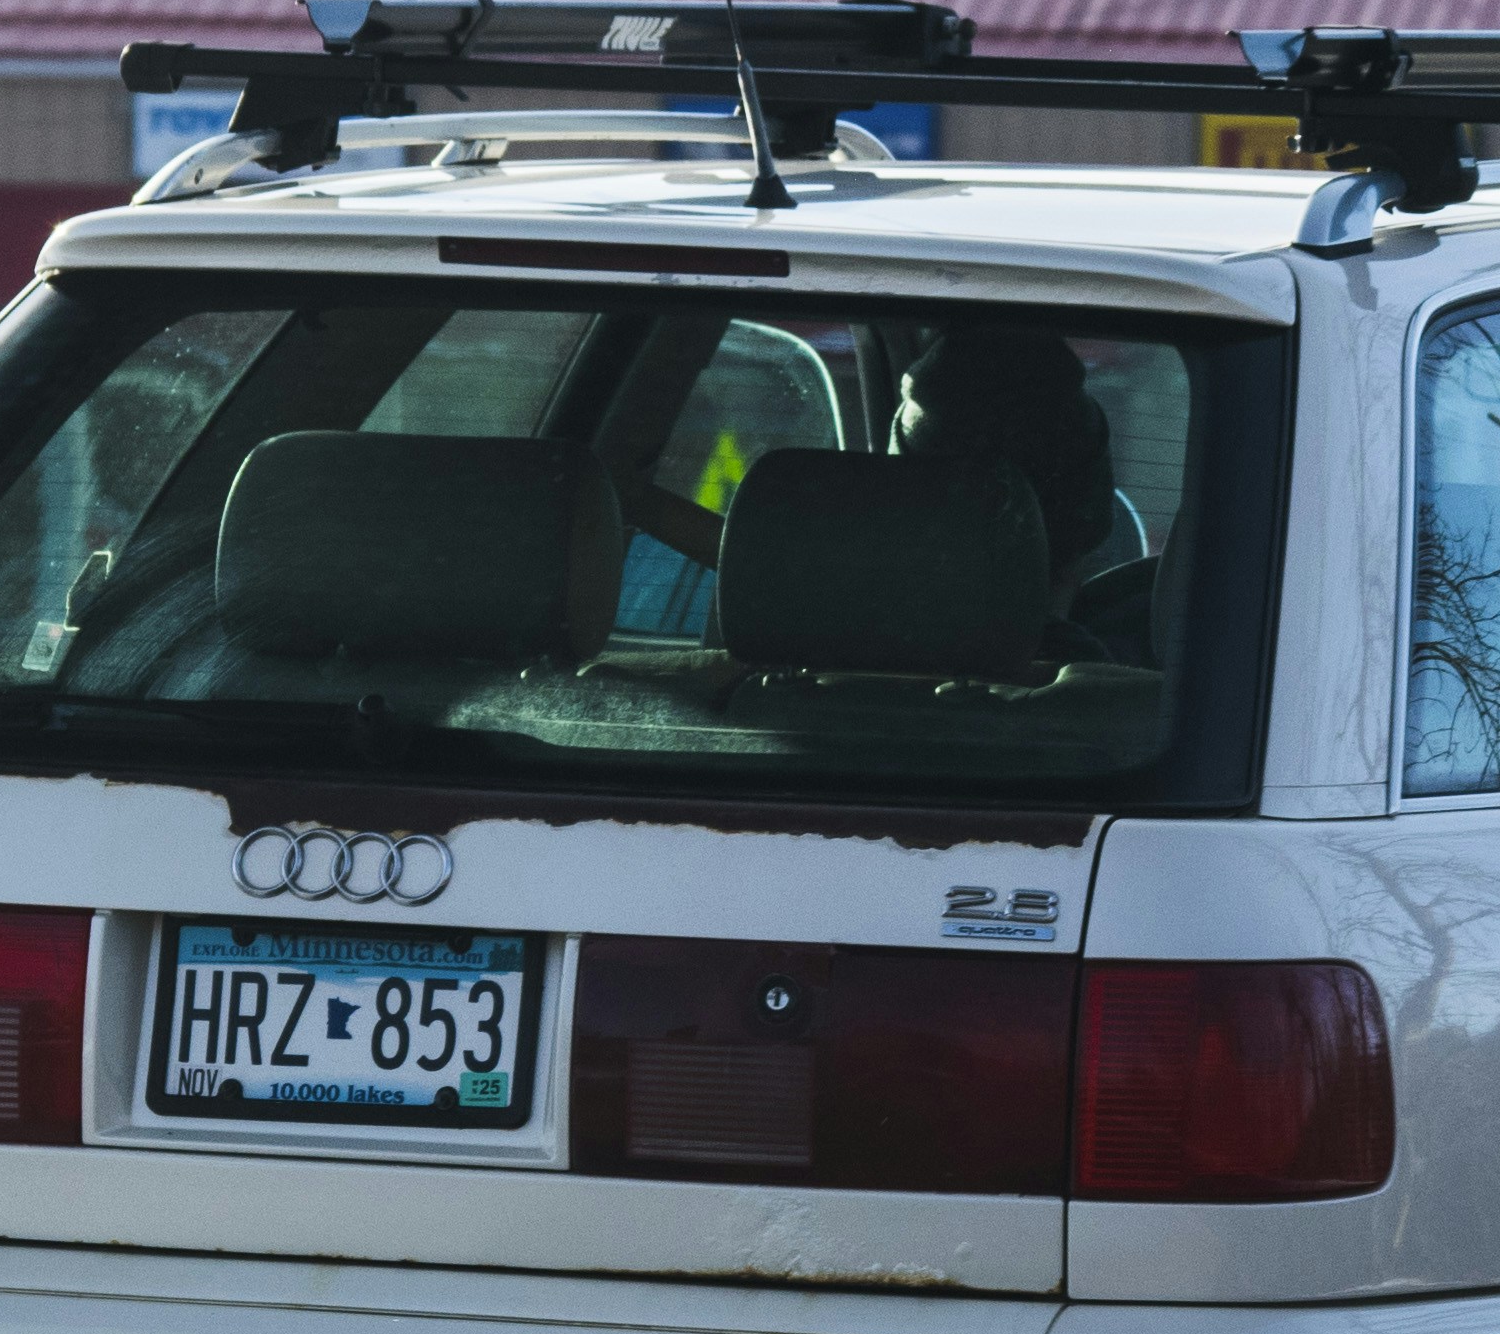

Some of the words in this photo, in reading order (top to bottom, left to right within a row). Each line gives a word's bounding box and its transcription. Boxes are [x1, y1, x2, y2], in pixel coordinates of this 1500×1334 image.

[600, 15, 676, 51] THULE
[958, 925, 1036, 937] quattro
[191, 944, 260, 957] EXPLORE
[178, 969, 316, 1067] HRZ
[371, 976, 505, 1074] 853
[178, 1067, 219, 1097] NOV
[479, 1079, 501, 1095] 25
[347, 1084, 405, 1104] lakes
